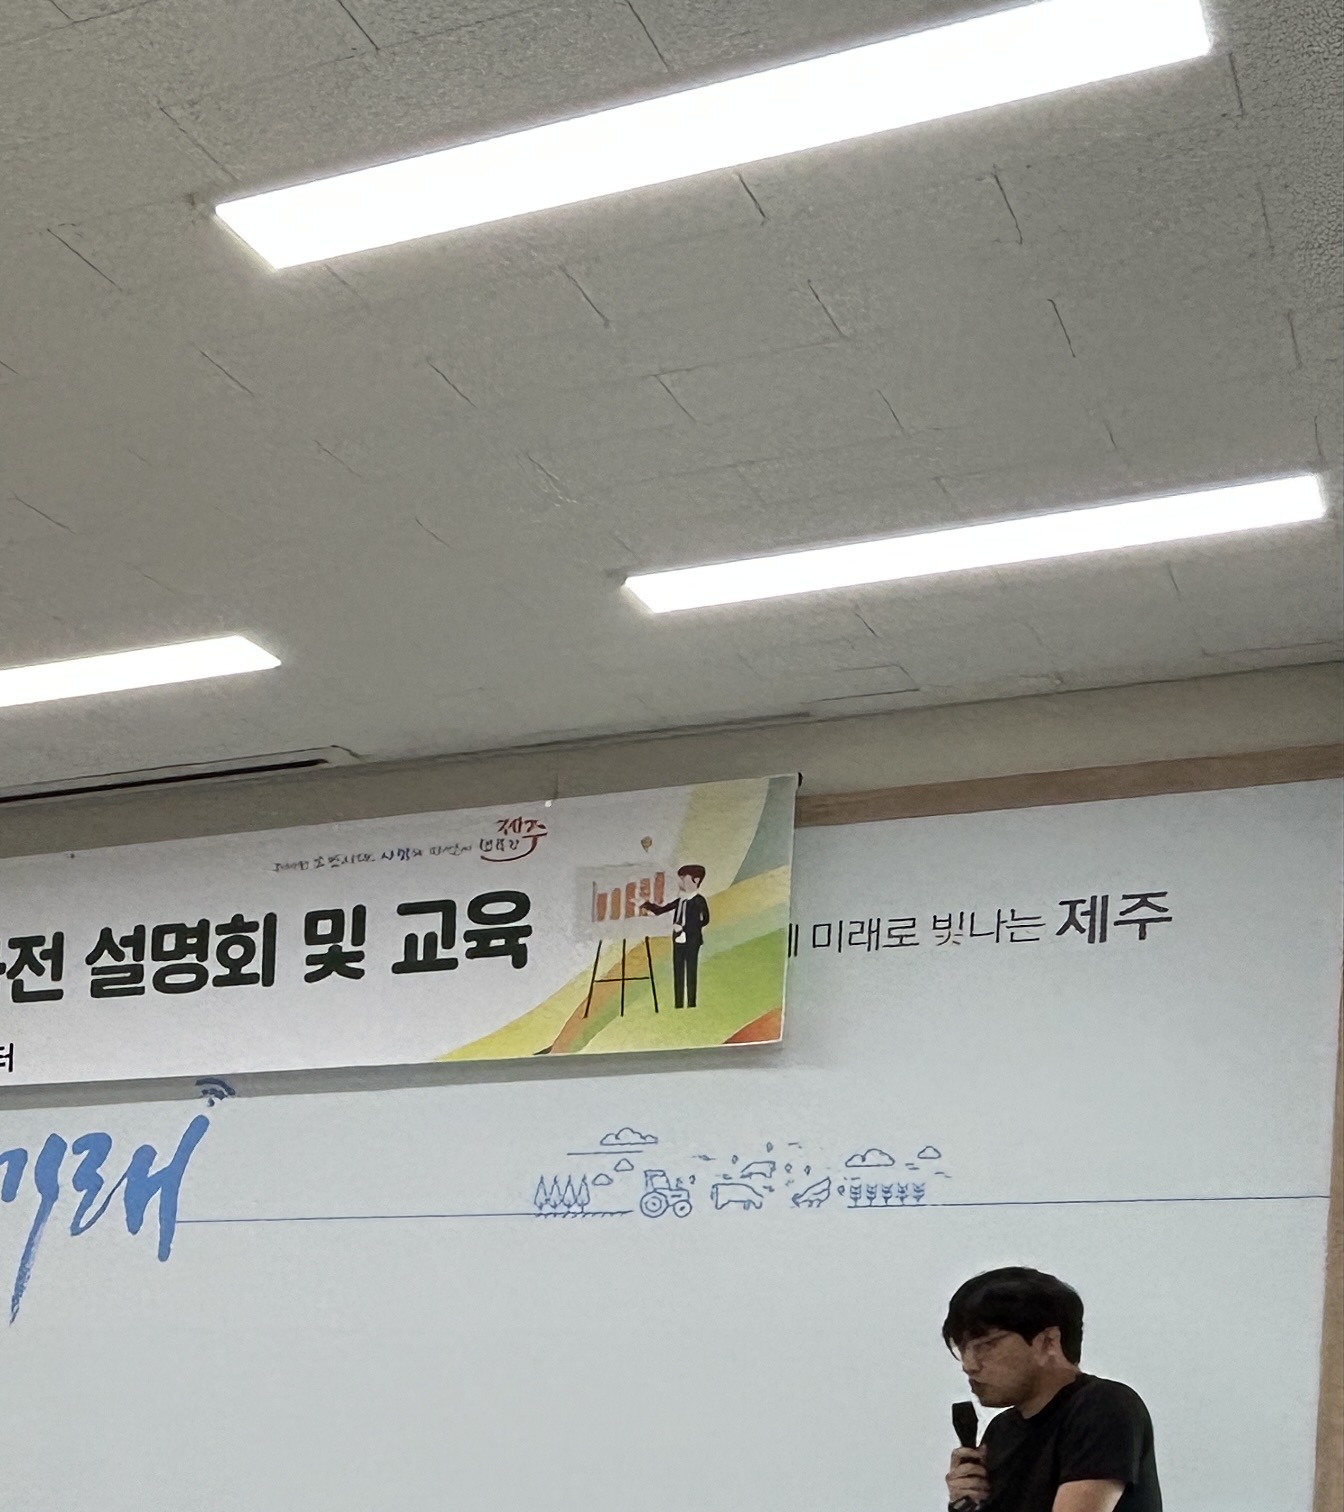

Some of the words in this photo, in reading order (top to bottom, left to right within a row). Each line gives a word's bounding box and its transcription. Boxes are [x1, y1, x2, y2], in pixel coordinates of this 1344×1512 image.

[84, 911, 278, 999] 설명회
[303, 903, 367, 984] 및
[391, 890, 533, 975] 교육
[812, 917, 920, 953] 미래로
[932, 908, 1046, 946] 빛나는
[1055, 891, 1173, 944] 제주
